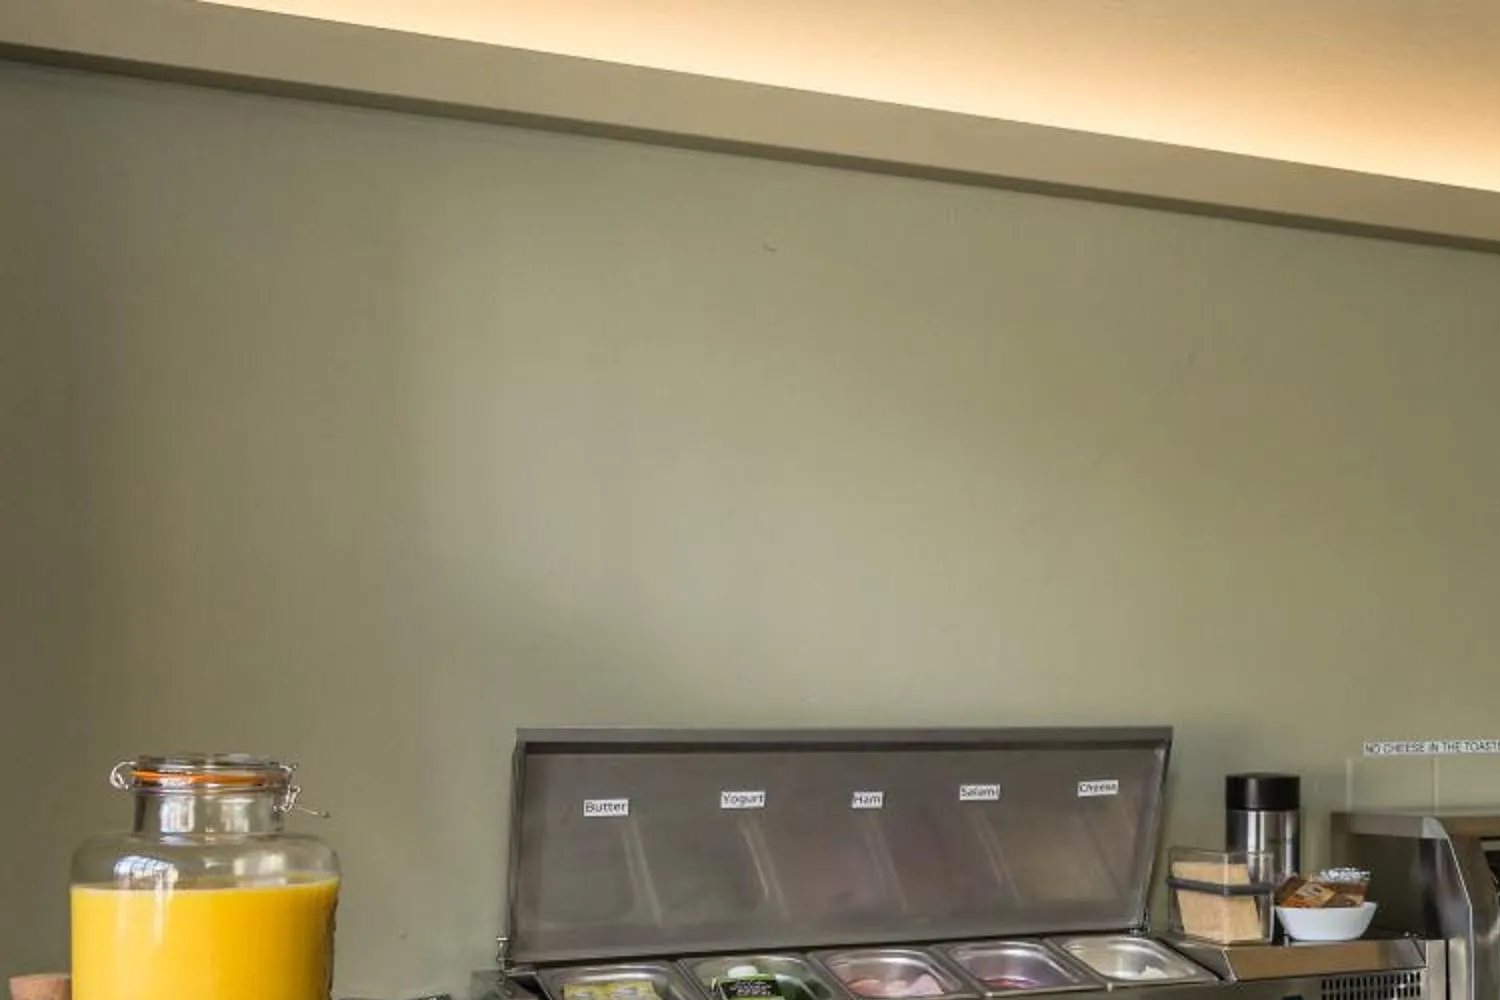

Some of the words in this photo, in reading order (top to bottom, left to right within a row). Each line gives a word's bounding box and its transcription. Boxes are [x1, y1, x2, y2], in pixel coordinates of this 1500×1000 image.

[1365, 742, 1381, 753] NO
[1430, 740, 1439, 752] IN
[1443, 740, 1461, 751] THE
[960, 786, 998, 798] Salami
[723, 793, 764, 807] Yogurt
[853, 793, 882, 806] Ham
[585, 801, 628, 813] Butter
